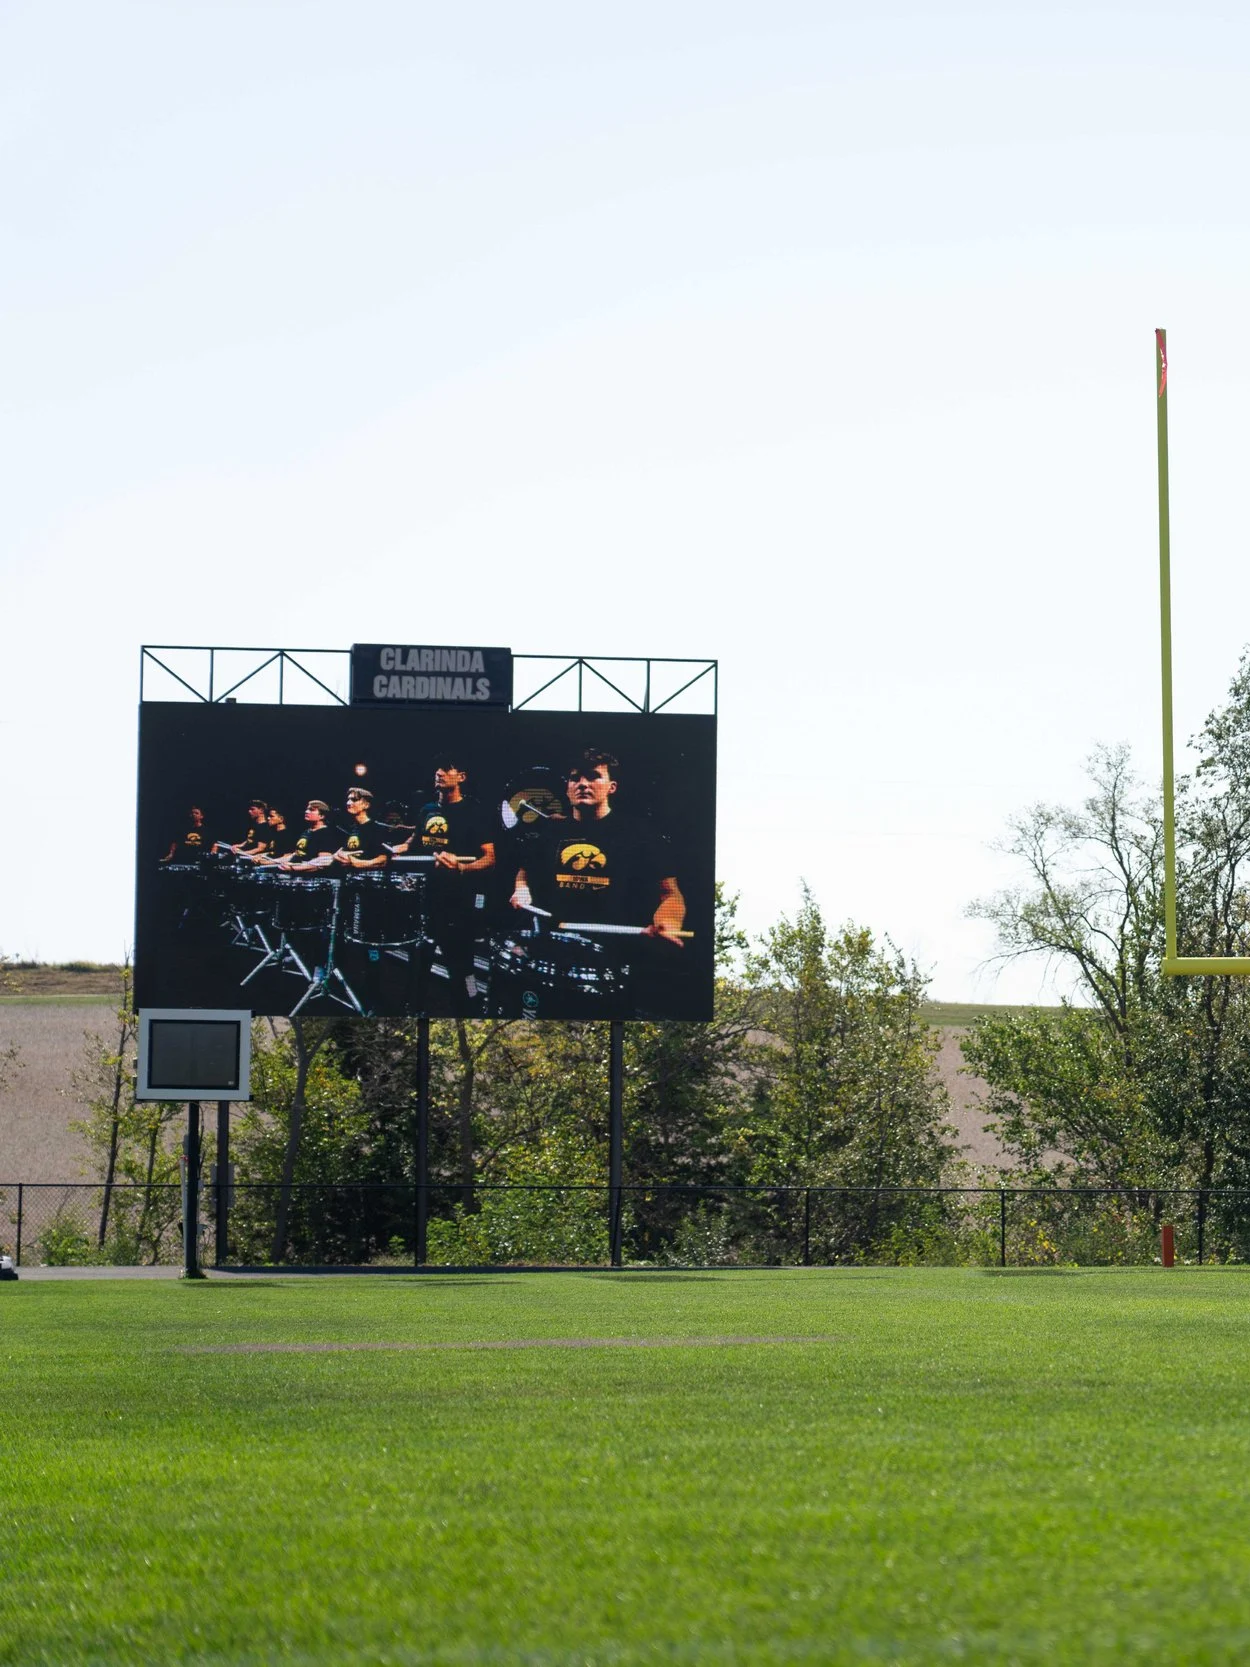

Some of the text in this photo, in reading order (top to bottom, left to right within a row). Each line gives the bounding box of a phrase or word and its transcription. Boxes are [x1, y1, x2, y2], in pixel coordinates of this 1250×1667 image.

[380, 648, 485, 673] CLARINDA
[373, 675, 491, 700] CARDINALS
[559, 882, 586, 890] BAND
